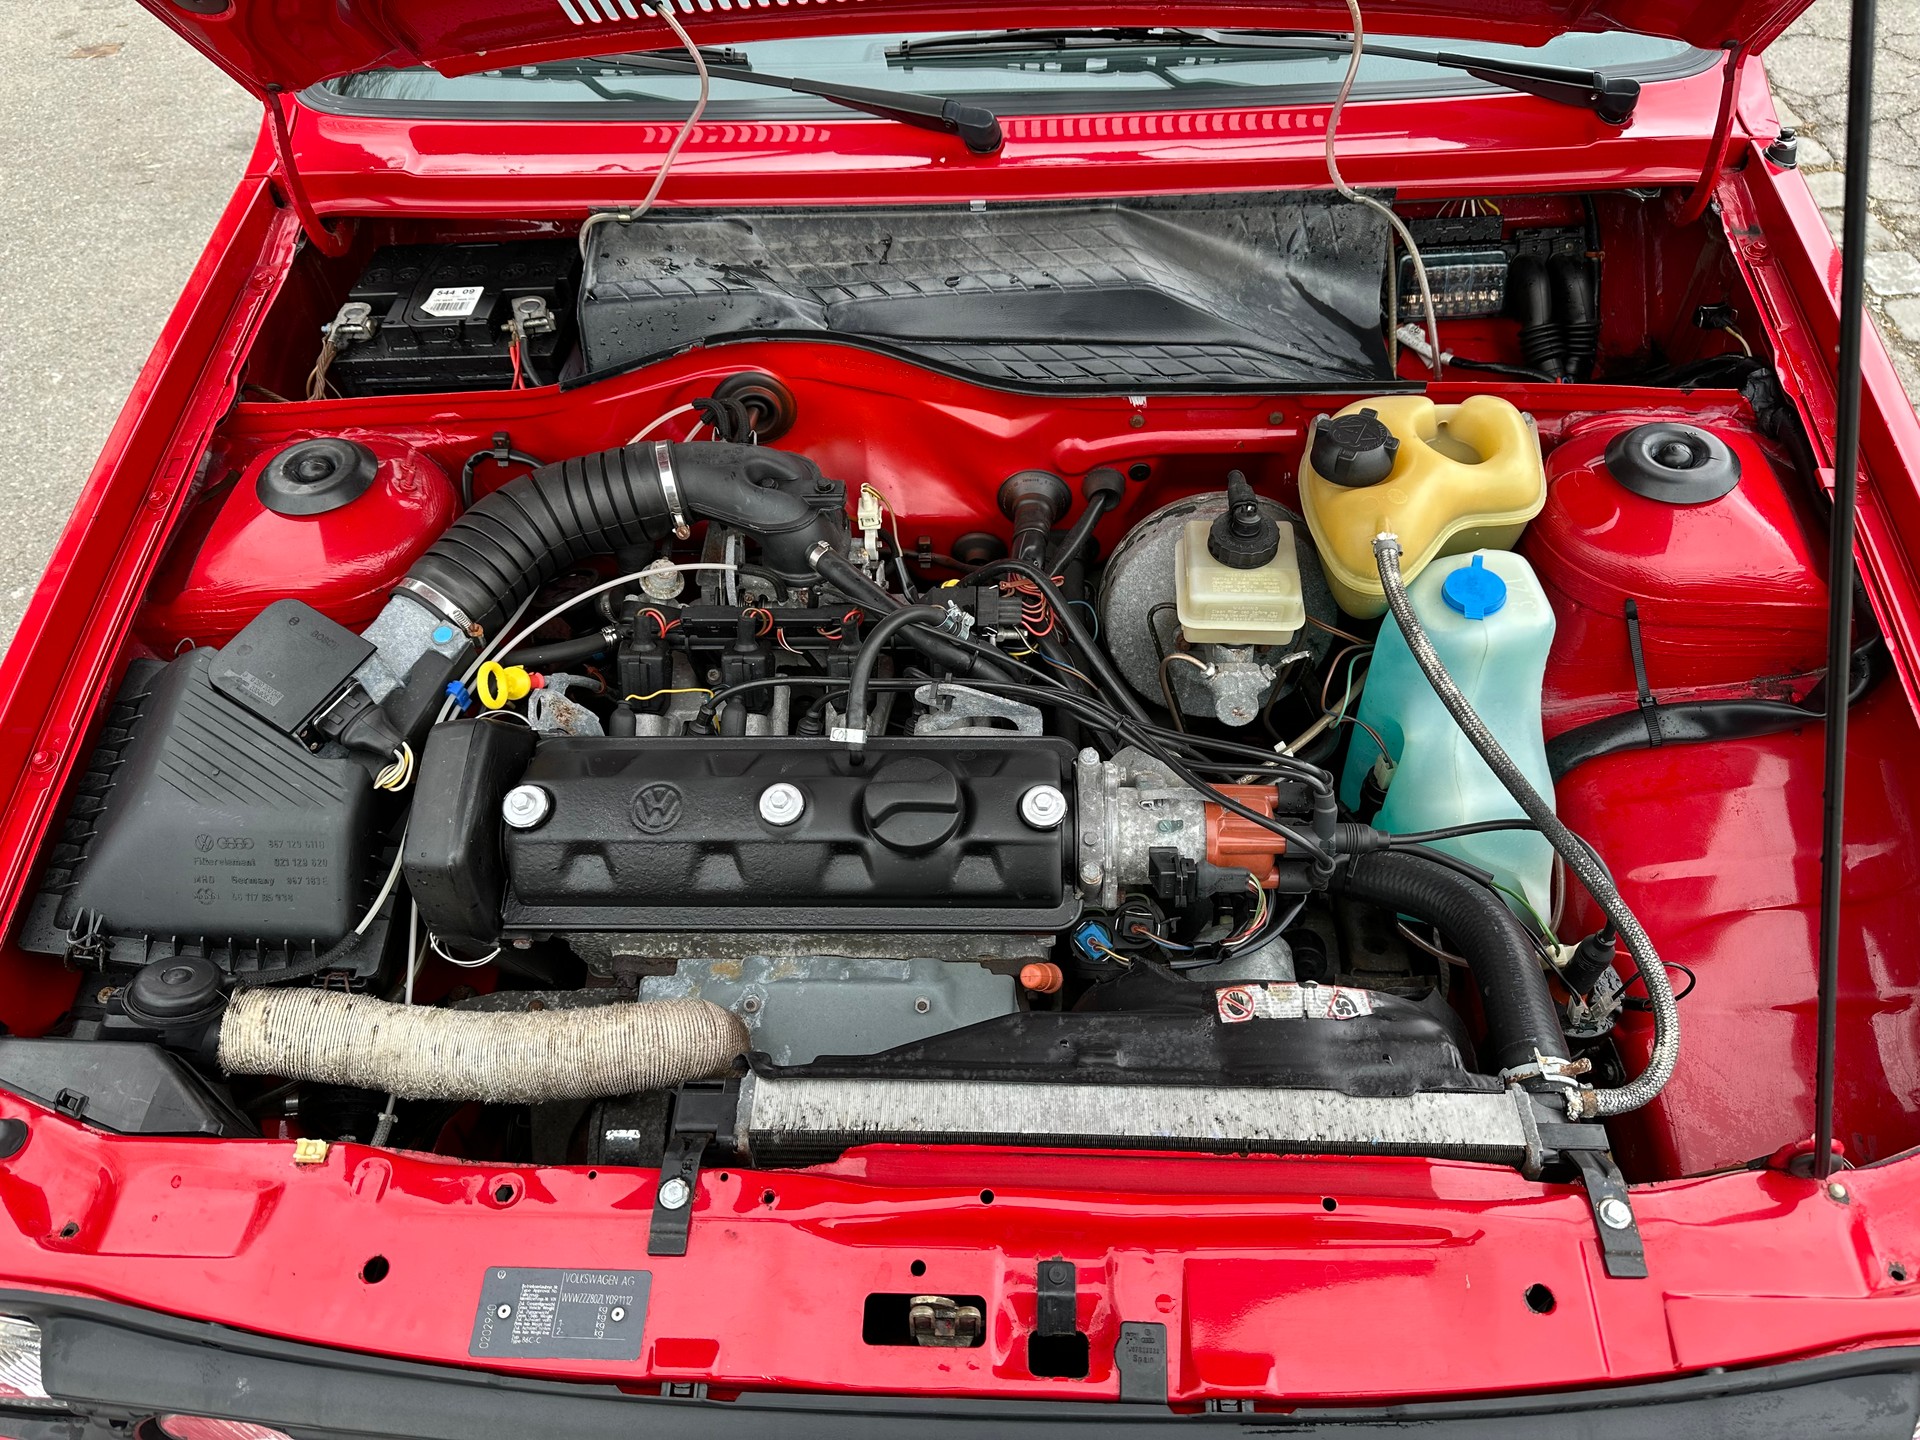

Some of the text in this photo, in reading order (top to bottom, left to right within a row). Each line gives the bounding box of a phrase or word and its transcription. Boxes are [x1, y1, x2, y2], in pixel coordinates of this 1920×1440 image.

[436, 287, 475, 297] 544 09
[565, 1272, 619, 1286] VOLKSWAGEN
[621, 1276, 636, 1287] AG
[597, 1305, 609, 1315] kg
[596, 1313, 607, 1323] kg
[478, 1303, 498, 1349] 0202940
[595, 1321, 606, 1331] kg
[593, 1329, 605, 1340] kg
[1132, 1354, 1155, 1365] Spain
